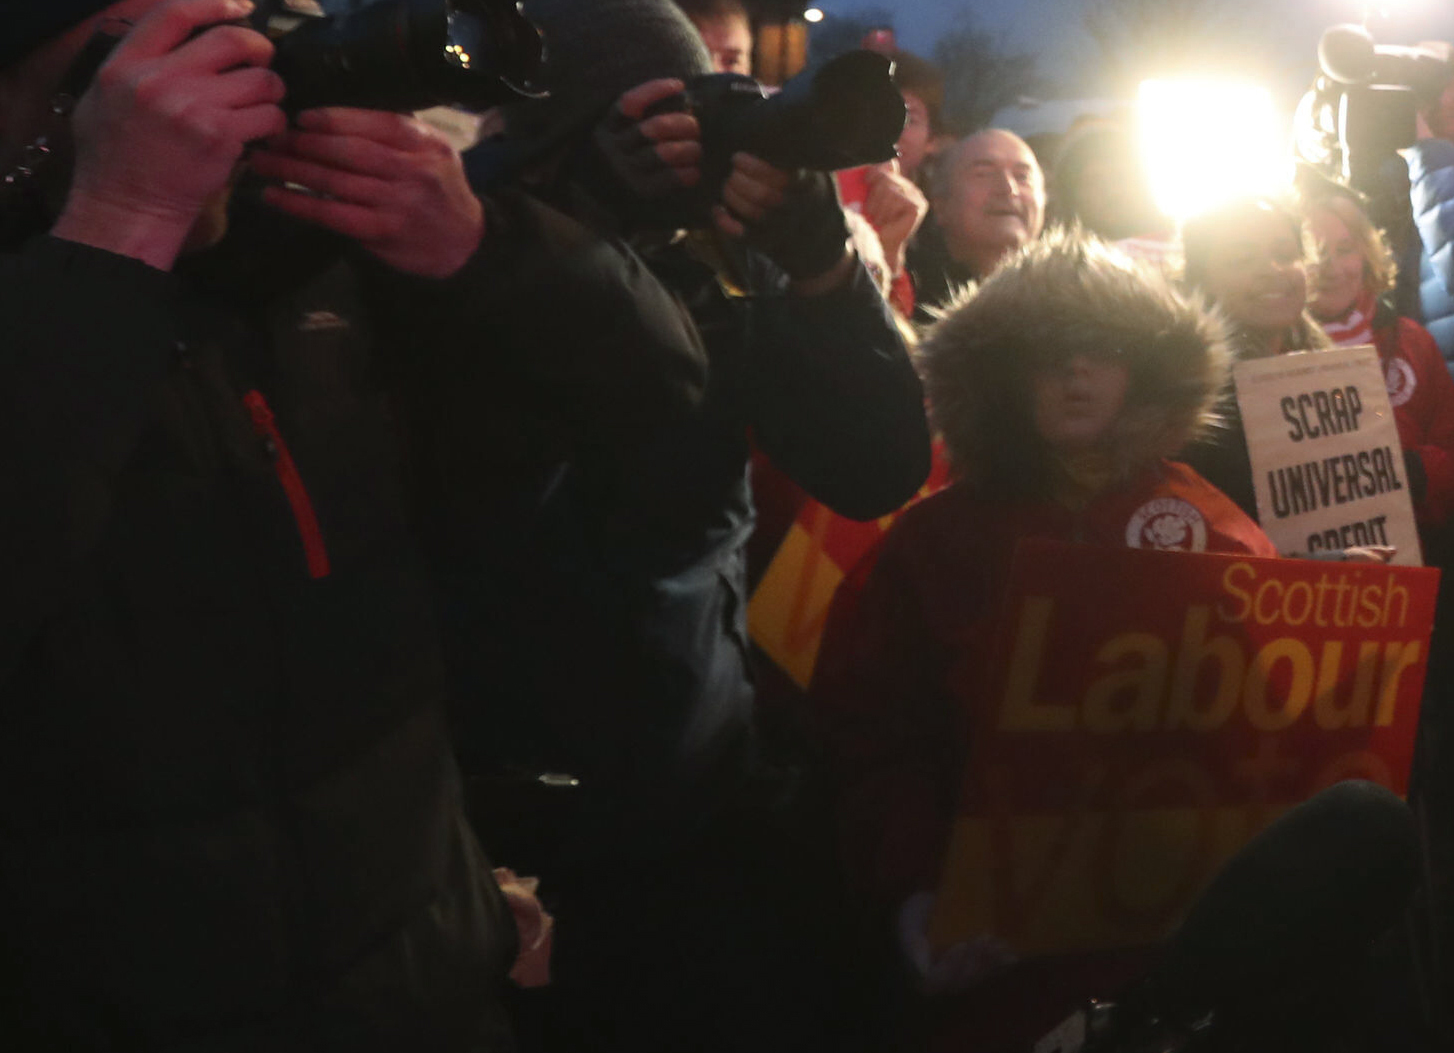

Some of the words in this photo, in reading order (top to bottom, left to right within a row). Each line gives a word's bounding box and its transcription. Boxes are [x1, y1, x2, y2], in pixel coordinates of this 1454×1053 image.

[1280, 385, 1362, 442] SCRAP
[1267, 445, 1402, 519] UNIVERSAL
[1218, 561, 1411, 629] Scottish
[1001, 595, 1422, 733] Labour
